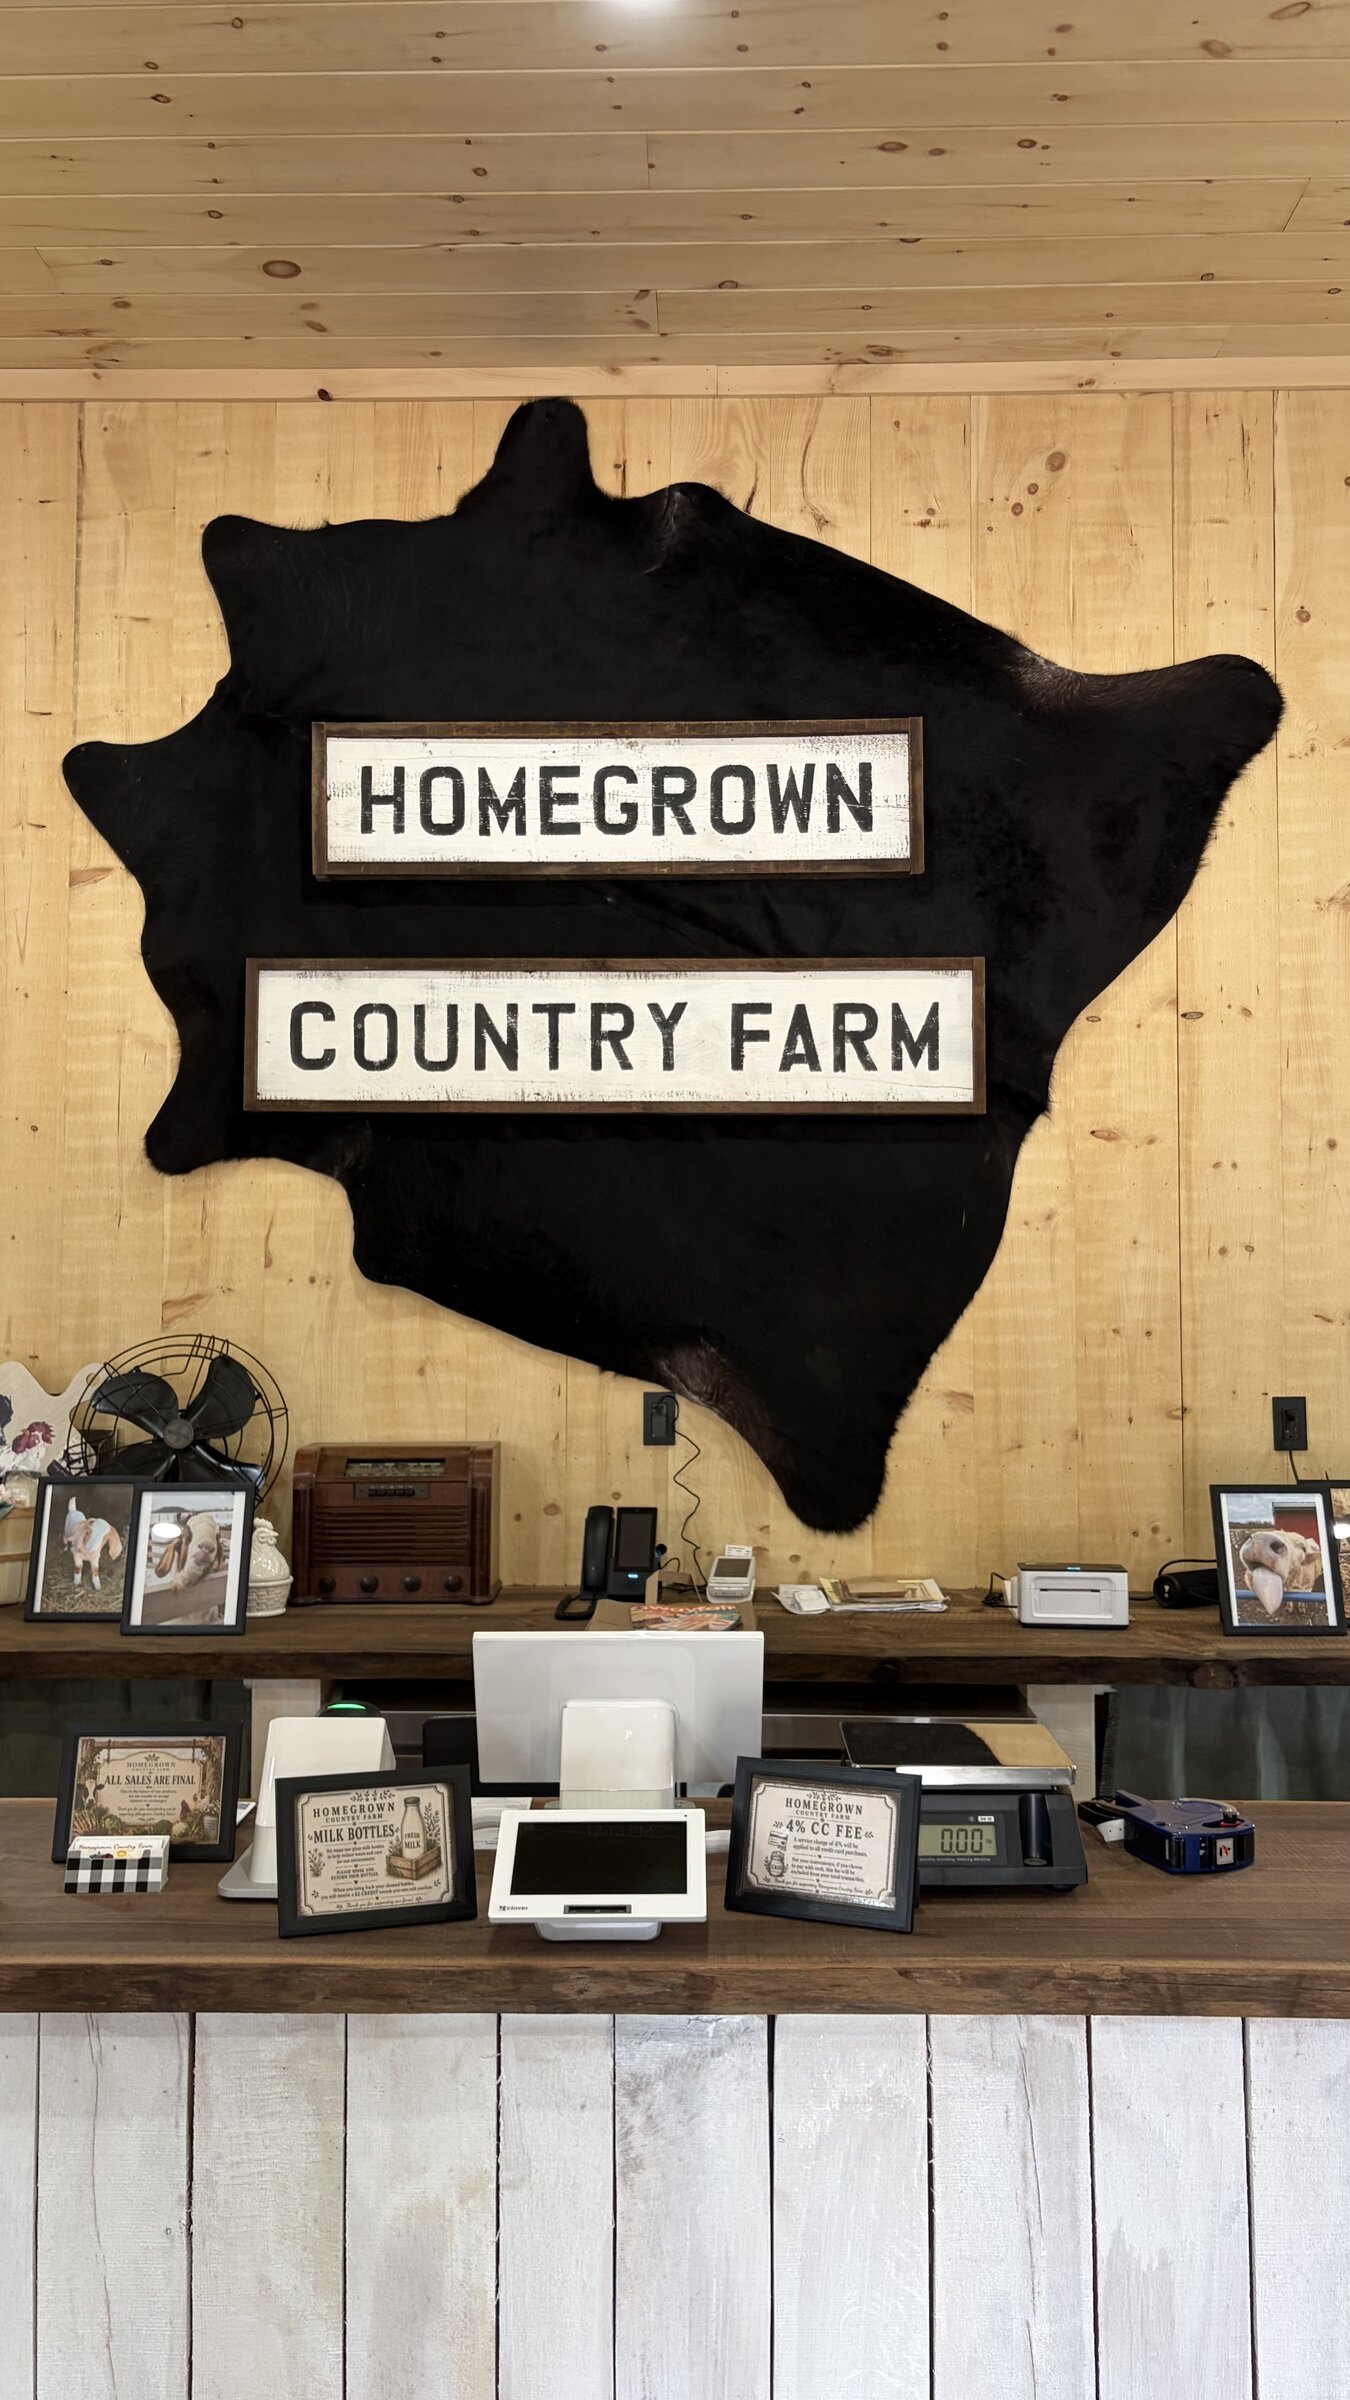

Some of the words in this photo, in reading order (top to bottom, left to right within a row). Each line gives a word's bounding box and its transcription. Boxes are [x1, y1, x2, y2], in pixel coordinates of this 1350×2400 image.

[359, 762, 875, 837] HOMEGROWN
[289, 1001, 688, 1072] COUNTRY
[730, 1001, 941, 1073] FARM
[105, 1775, 122, 1785] ALL
[125, 1775, 152, 1785] SALES
[154, 1775, 170, 1785] ARE
[172, 1775, 196, 1785] FINAL
[313, 1802, 394, 1818] HOMEGROWN
[785, 1798, 863, 1815] HOMEGROWN
[796, 1810, 828, 1818] COUNTRY
[326, 1815, 360, 1823] COUNTRY
[314, 1828, 344, 1844] MILK
[348, 1824, 395, 1841] BOTTLES
[786, 1819, 805, 1833] 4%
[811, 1822, 830, 1836] CC
[836, 1824, 862, 1840] FEE
[404, 1840, 421, 1849] MILK
[941, 1828, 983, 1854] 0.00
